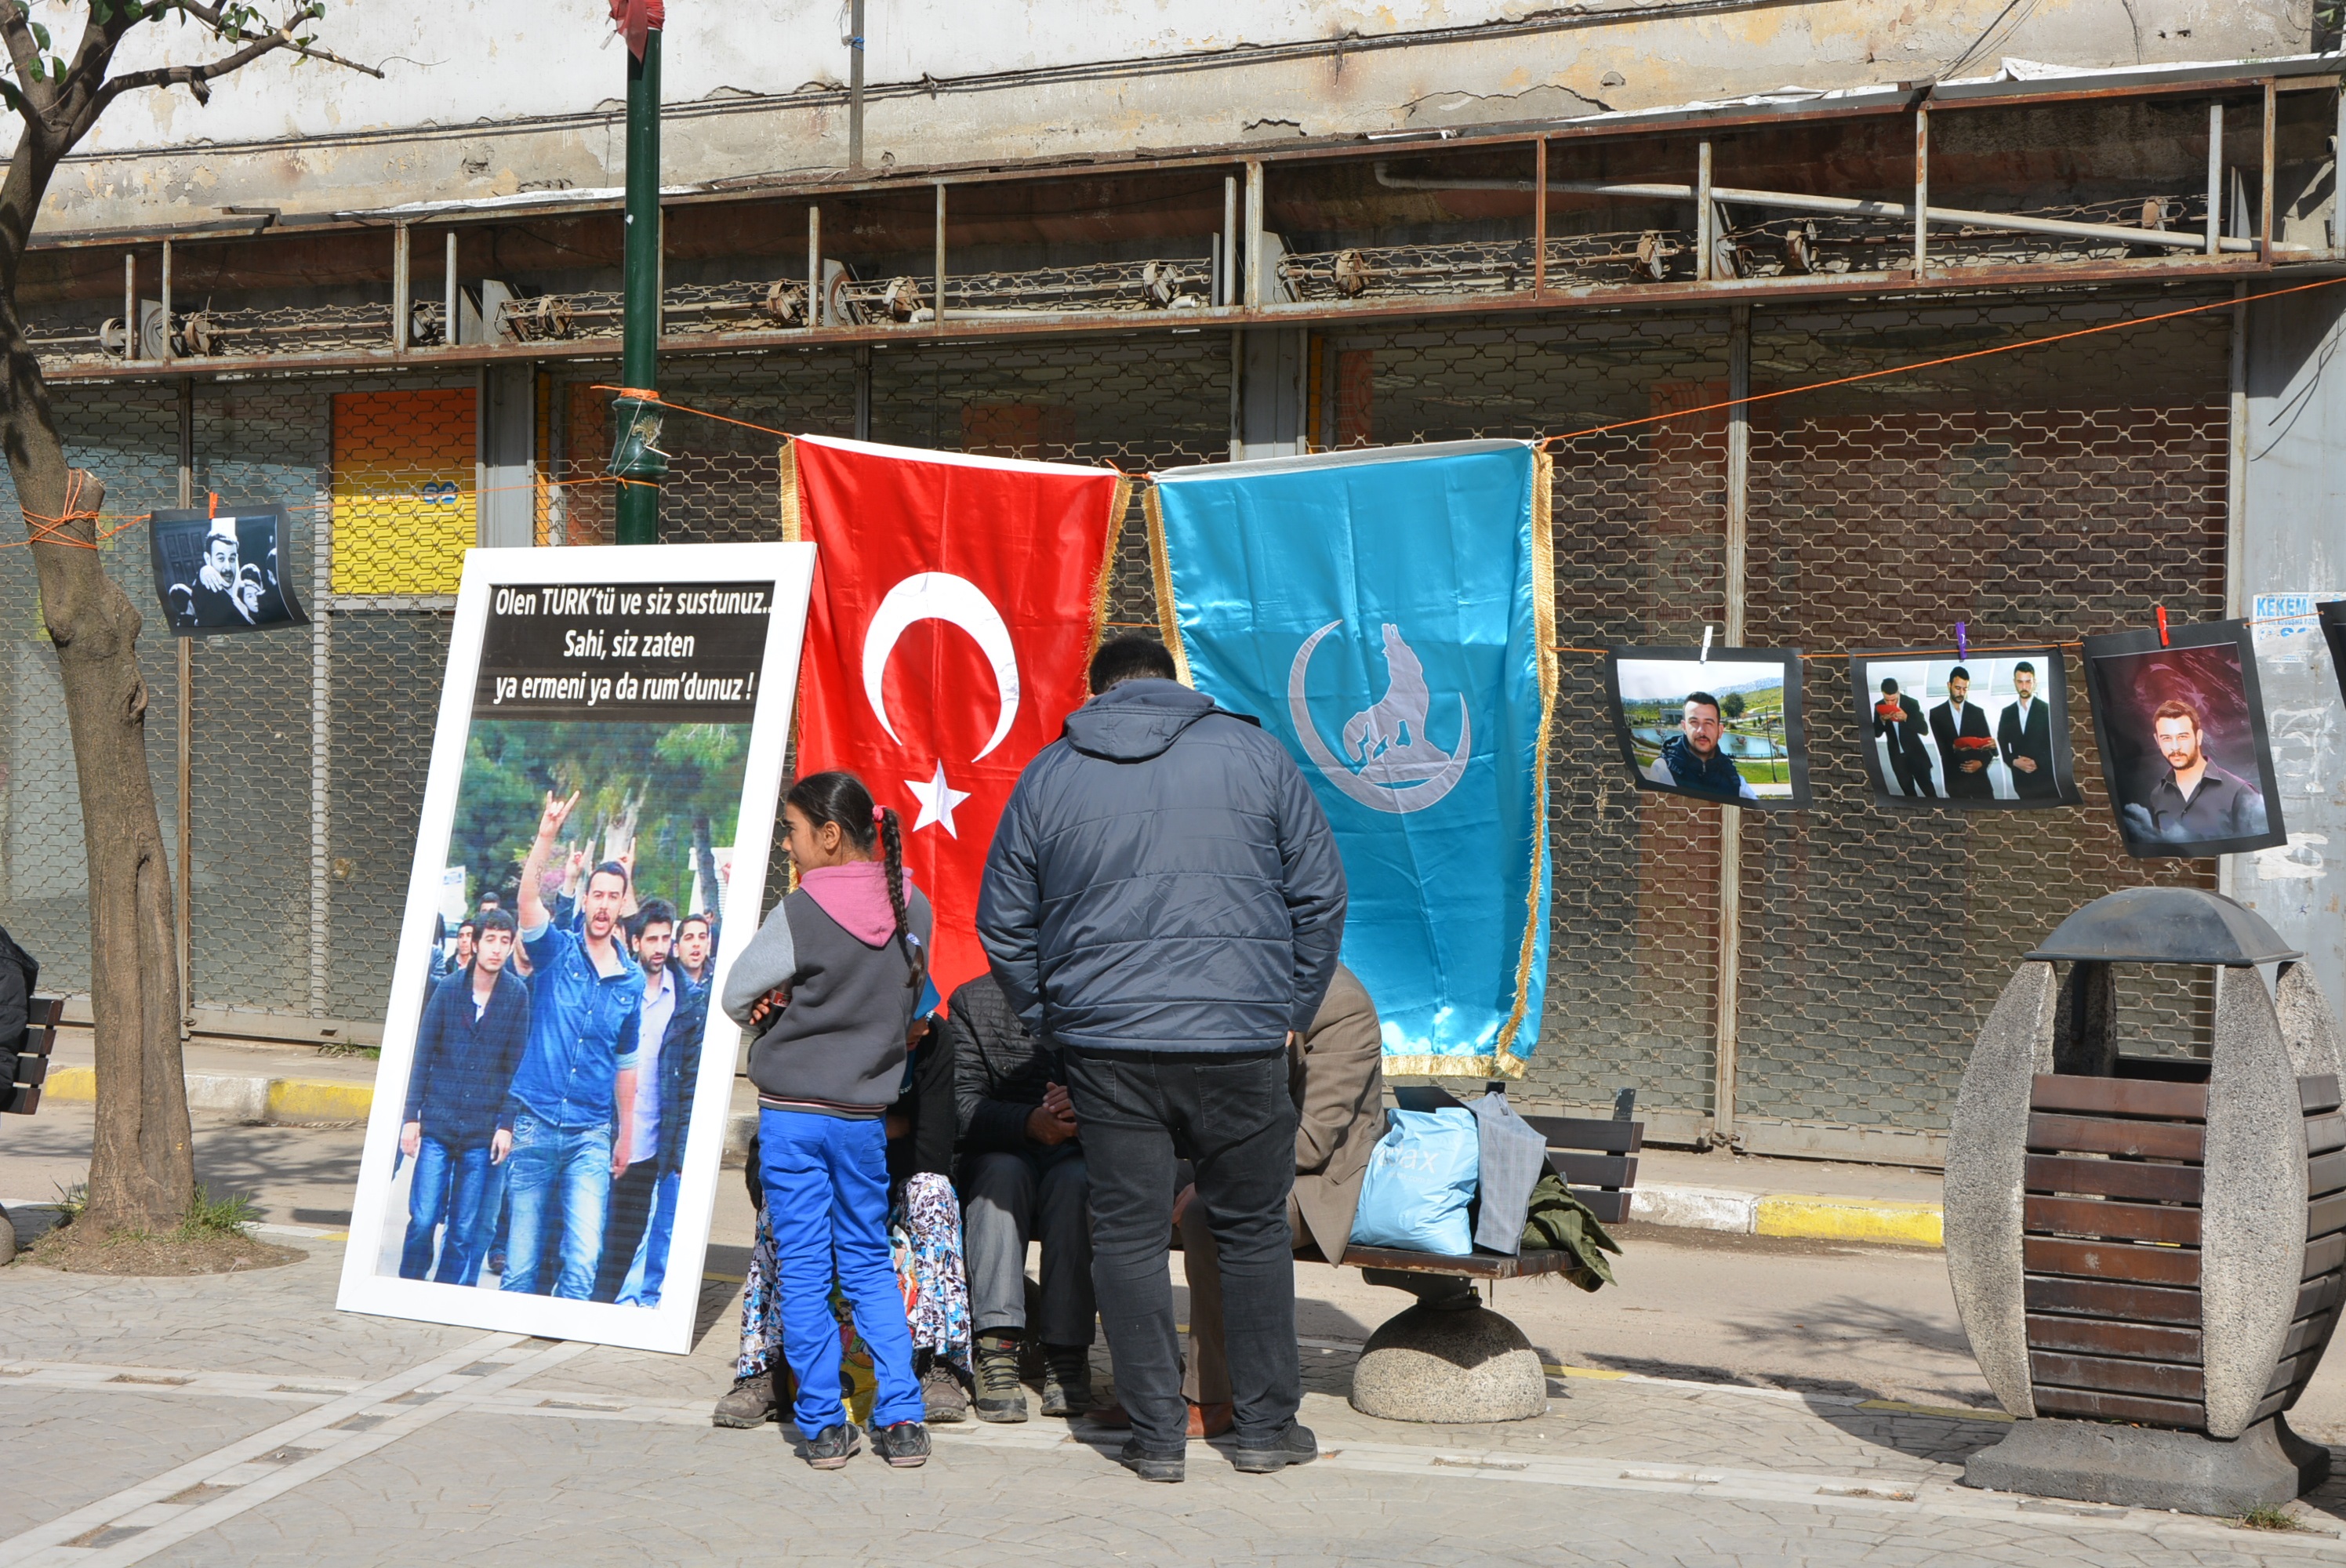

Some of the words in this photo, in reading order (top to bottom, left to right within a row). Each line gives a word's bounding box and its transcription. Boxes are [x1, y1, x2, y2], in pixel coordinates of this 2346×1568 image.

[620, 592, 641, 615] ve
[645, 586, 673, 615] siz
[563, 629, 607, 660] Sahi,
[611, 629, 639, 657] siz
[641, 631, 695, 657] zaten
[492, 677, 518, 705] ya
[521, 671, 587, 699] ermeni
[586, 677, 612, 706] ya
[615, 671, 639, 699] da
